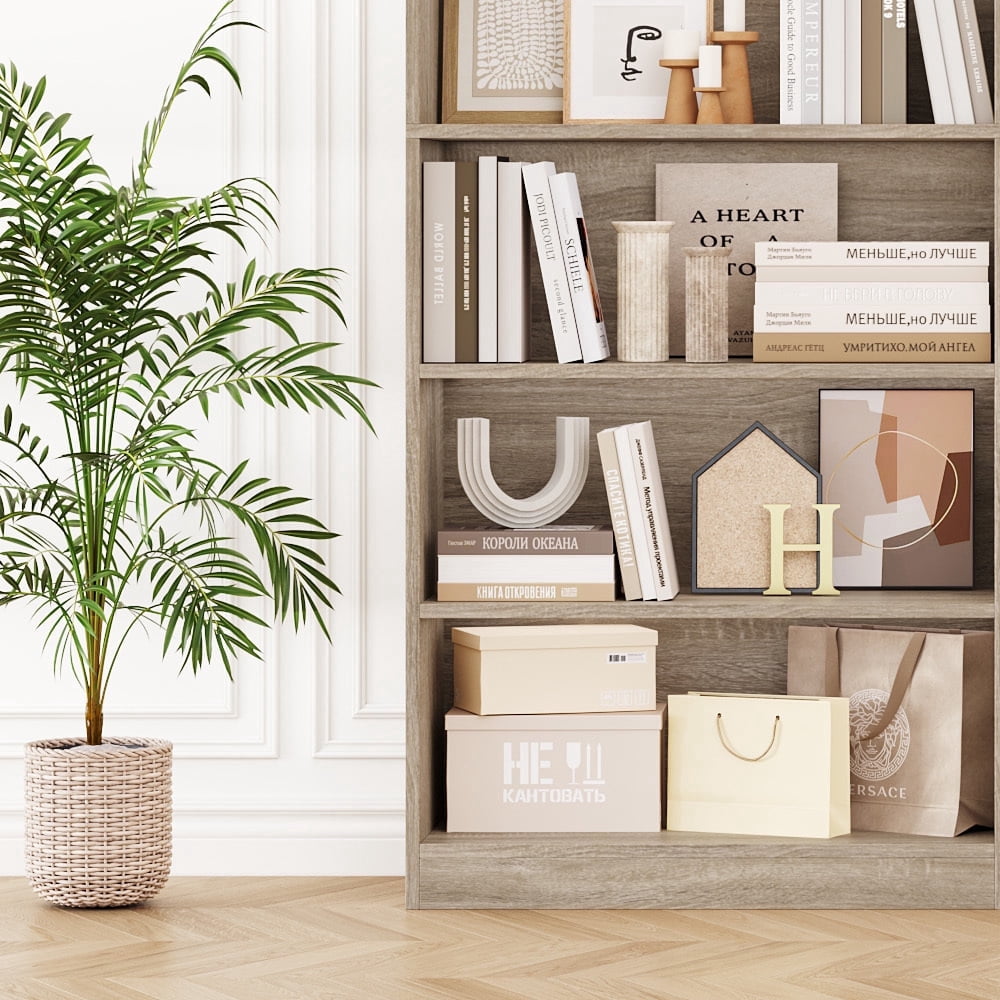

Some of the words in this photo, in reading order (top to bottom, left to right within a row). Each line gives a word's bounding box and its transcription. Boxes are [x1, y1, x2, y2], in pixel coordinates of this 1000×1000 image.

[532, 193, 545, 217] JODI
[690, 209, 708, 224] A
[716, 208, 805, 222] HEART
[538, 218, 557, 261] PICOULT
[700, 234, 734, 248] OF
[564, 238, 584, 294] SCHIELE
[606, 469, 627, 519] СПАСИТЕ
[482, 536, 529, 550] КОРОЛИ
[532, 536, 579, 550] ОКЕАНА
[615, 521, 635, 568] КОТИКА!
[763, 504, 840, 595] H
[476, 586, 505, 599] КНИГА
[504, 585, 557, 599] ОТКРОВЕНИЯ
[503, 741, 554, 785] НЕ
[503, 788, 606, 804] КАНТОВАТЬ
[850, 784, 907, 800] ERSACE
